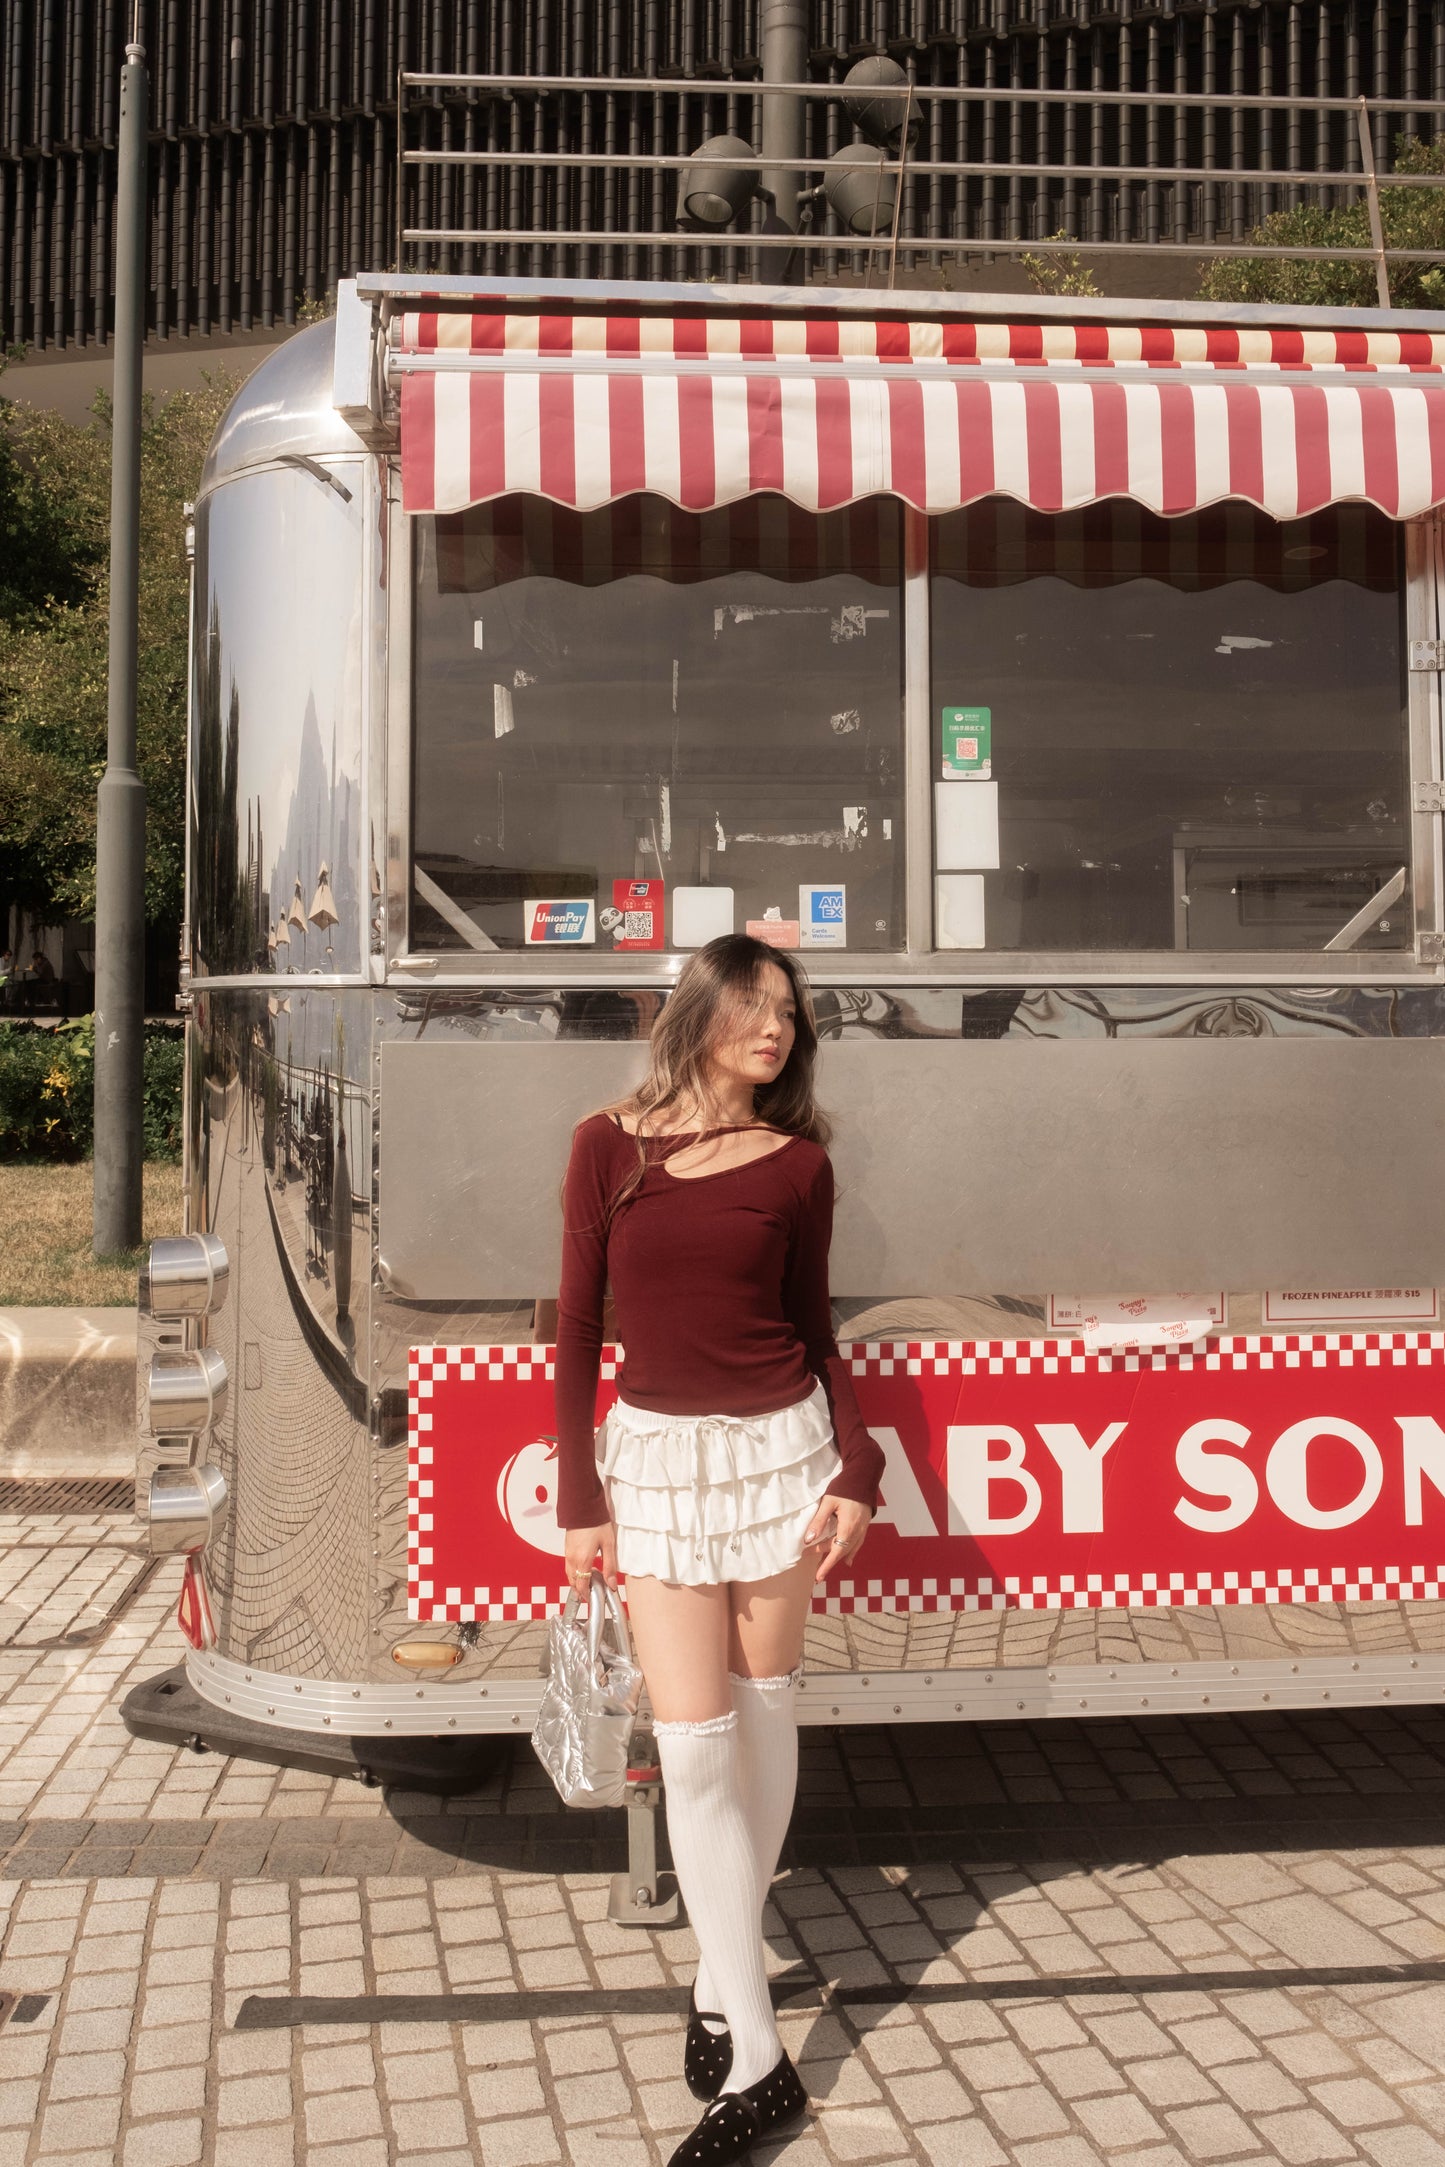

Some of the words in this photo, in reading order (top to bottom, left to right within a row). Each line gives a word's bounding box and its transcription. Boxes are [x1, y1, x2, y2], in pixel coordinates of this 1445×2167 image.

[819, 896, 843, 908] AM
[536, 911, 585, 926] UnionPay
[554, 922, 581, 934] 银联
[1282, 1291, 1321, 1301] FROZEN
[1322, 1290, 1373, 1300] PINEAPPLE
[1404, 1289, 1421, 1298] $15
